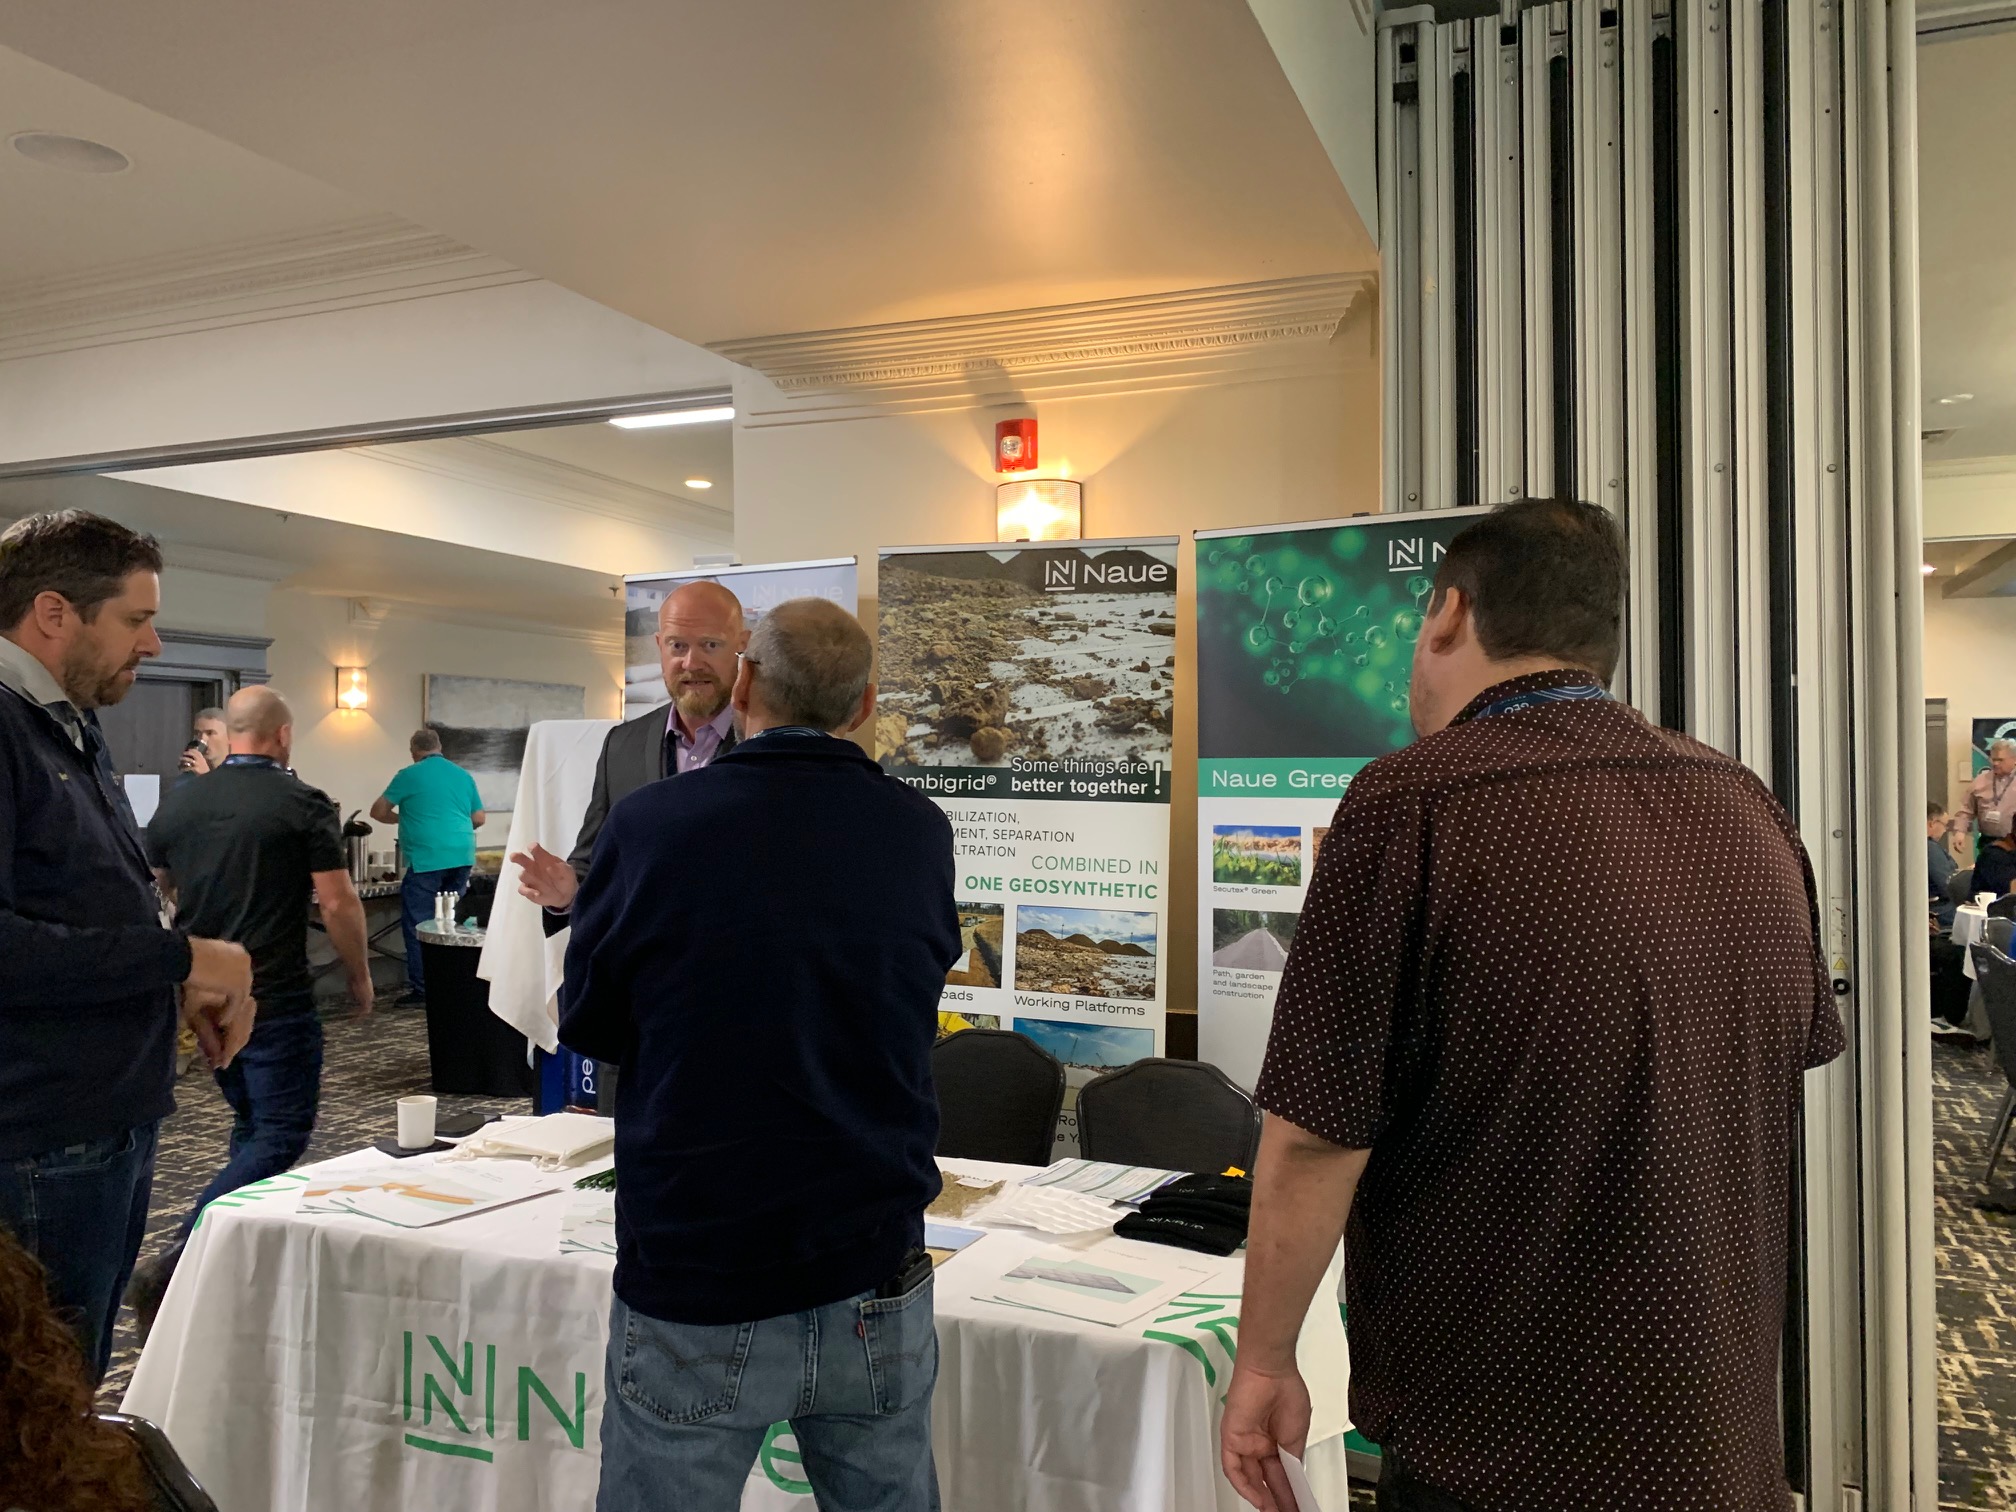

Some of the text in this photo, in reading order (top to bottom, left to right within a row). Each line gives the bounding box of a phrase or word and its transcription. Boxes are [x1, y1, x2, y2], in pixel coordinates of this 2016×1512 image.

[1083, 563, 1168, 584] Naue
[1011, 757, 1148, 777] Some things are
[1011, 776, 1064, 792] better
[1212, 769, 1277, 788] Naue
[992, 828, 1075, 843] SEPARATION
[1031, 855, 1159, 875] COMBINED IN
[965, 875, 1159, 900] ONE GEOSYNTHETIC
[1251, 887, 1277, 895] Green
[1212, 969, 1265, 981] Path, garden
[1212, 979, 1274, 992] and landscape
[1212, 988, 1265, 1000] construction
[1013, 994, 1146, 1016] Working Platforms
